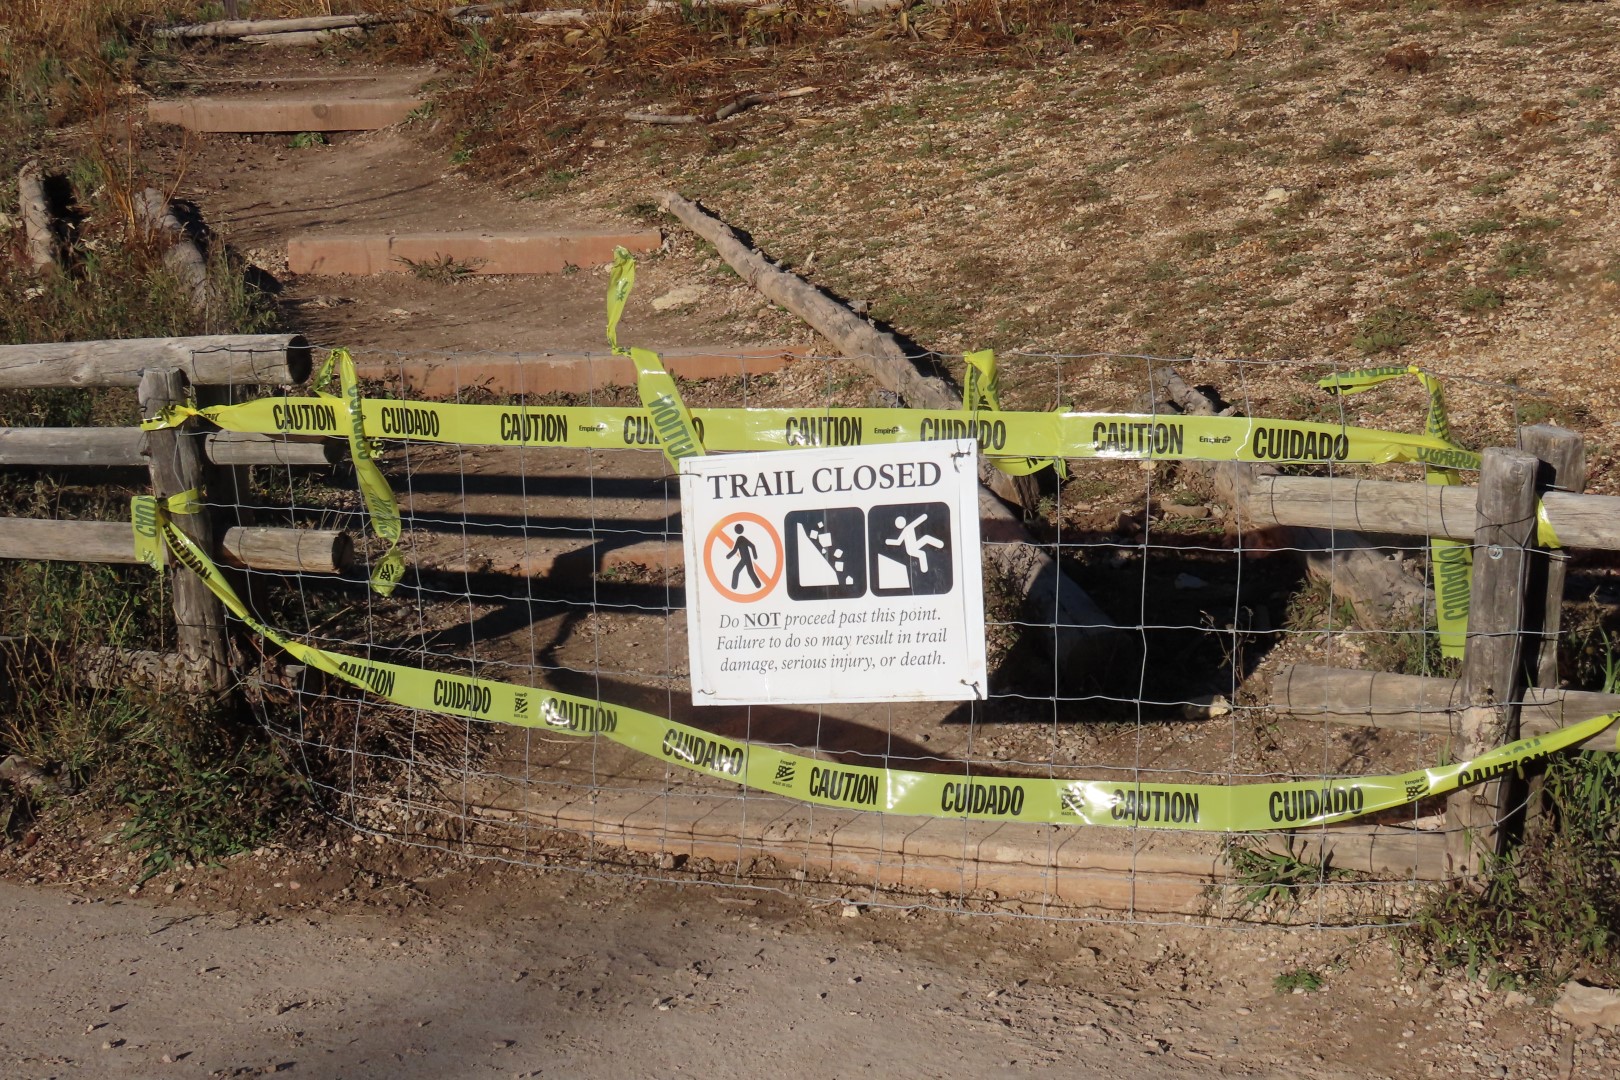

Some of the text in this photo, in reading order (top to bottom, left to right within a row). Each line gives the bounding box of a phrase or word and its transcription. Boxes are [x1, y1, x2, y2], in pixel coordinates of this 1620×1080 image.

[272, 404, 337, 431] CAUTION
[381, 406, 440, 438] CUIDADO
[501, 412, 568, 443] CAUTION
[785, 416, 862, 446] CAUTION
[920, 418, 1006, 450] CUIDADO
[1092, 421, 1184, 455] CAUTION
[1252, 427, 1349, 460] CUIDADO
[707, 461, 942, 499] TRAIL CLOSED
[720, 606, 942, 630] Do NOT proceed past this point.
[716, 627, 948, 651] Failure to do so may result in trail
[720, 651, 946, 675] damage, serious injury, or death.
[433, 678, 492, 714] CUIDADO
[545, 697, 618, 733] CAUTION
[661, 728, 745, 777] CUIDADO
[808, 766, 1025, 816] CAUTION CUIDADO
[1111, 785, 1364, 824] CAUTION CUIDADO
